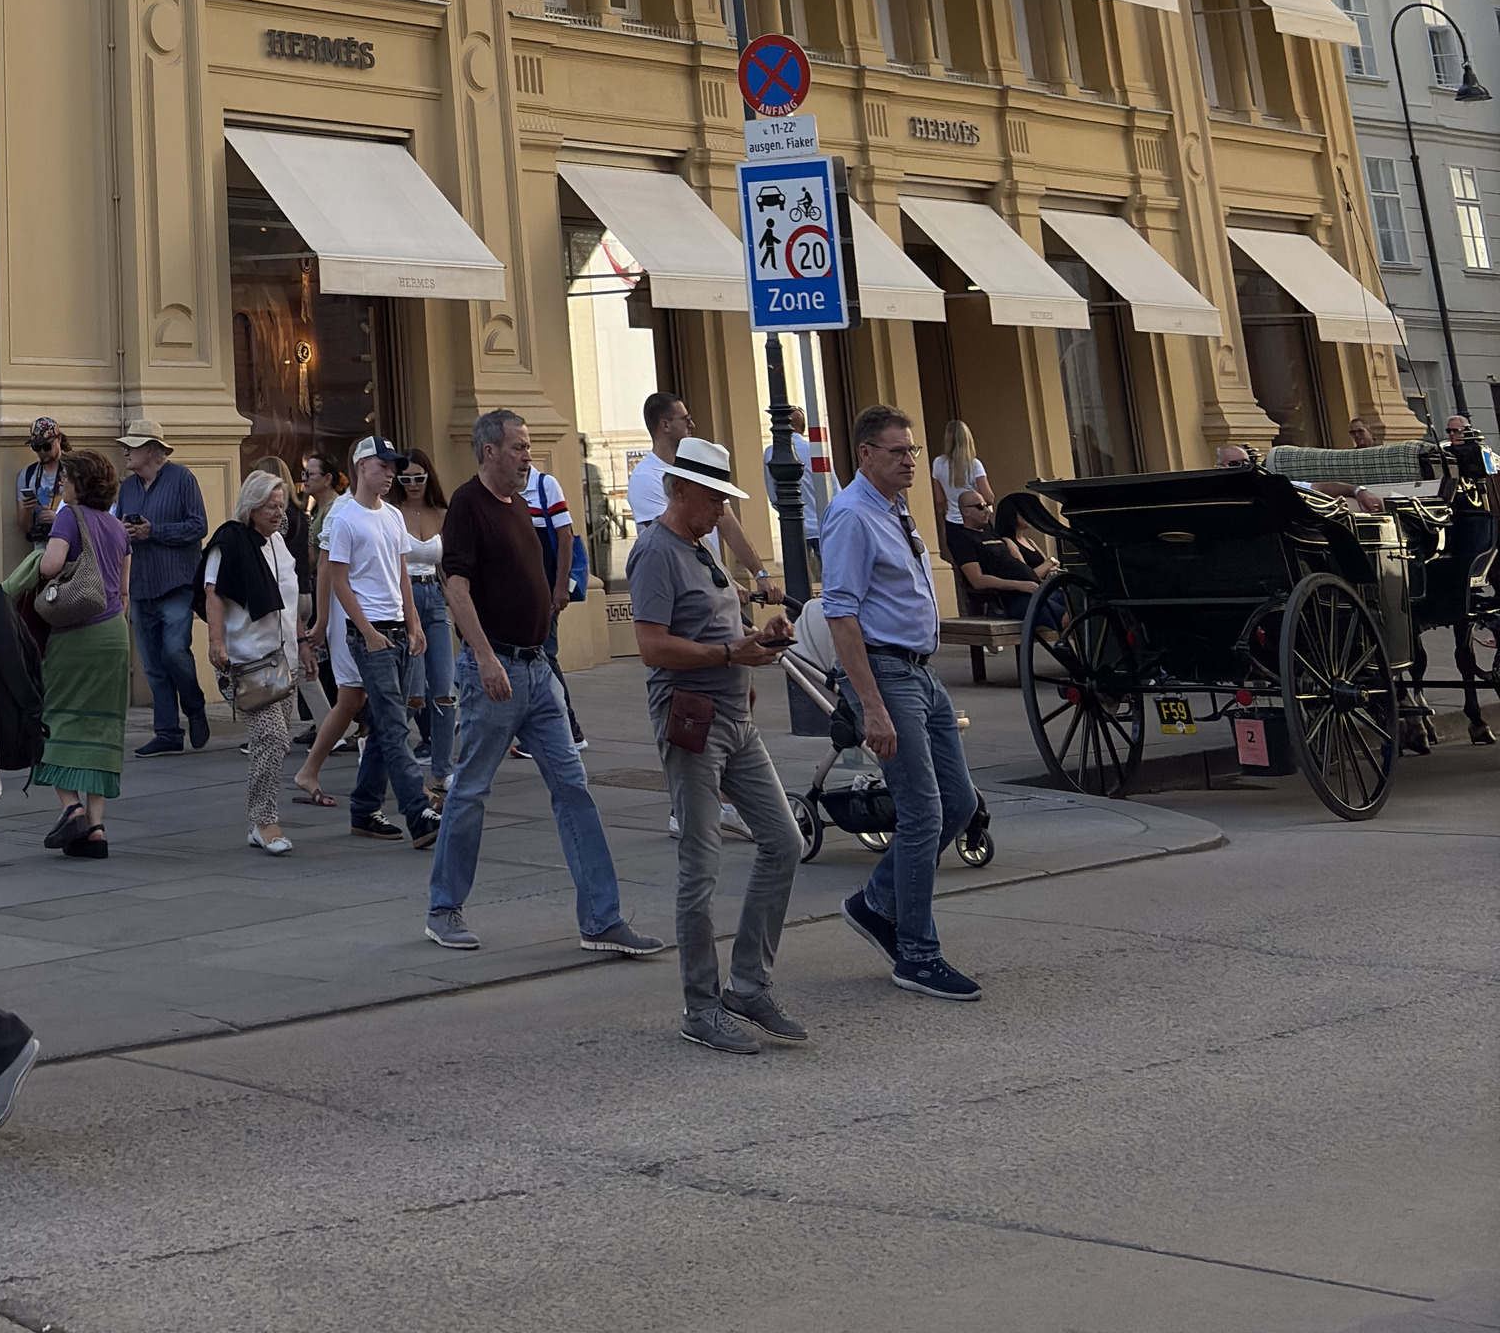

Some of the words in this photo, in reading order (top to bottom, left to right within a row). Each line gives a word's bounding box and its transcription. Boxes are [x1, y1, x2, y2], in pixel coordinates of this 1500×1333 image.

[758, 100, 798, 115] ANFANG
[749, 141, 784, 154] ausgen.
[786, 137, 814, 149] Fiaker
[798, 241, 825, 270] 20
[767, 287, 826, 312] Zone
[1160, 702, 1188, 720] F59
[1246, 730, 1256, 743] 2
